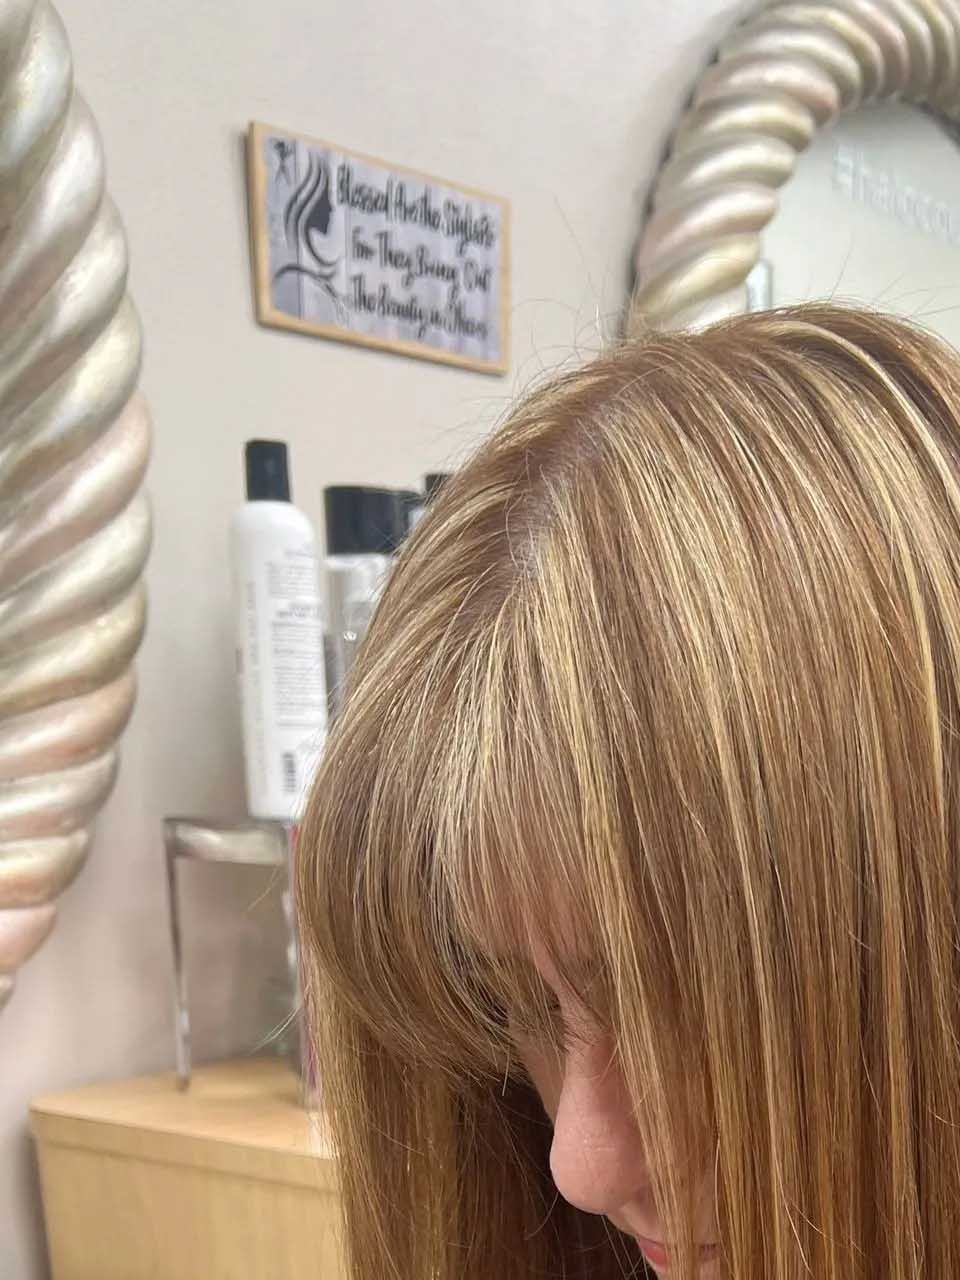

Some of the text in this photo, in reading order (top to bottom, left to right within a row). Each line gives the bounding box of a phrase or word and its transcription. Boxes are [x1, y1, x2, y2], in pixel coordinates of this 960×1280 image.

[337, 163, 393, 221] Blessed
[351, 225, 375, 260] For
[374, 230, 415, 290] They
